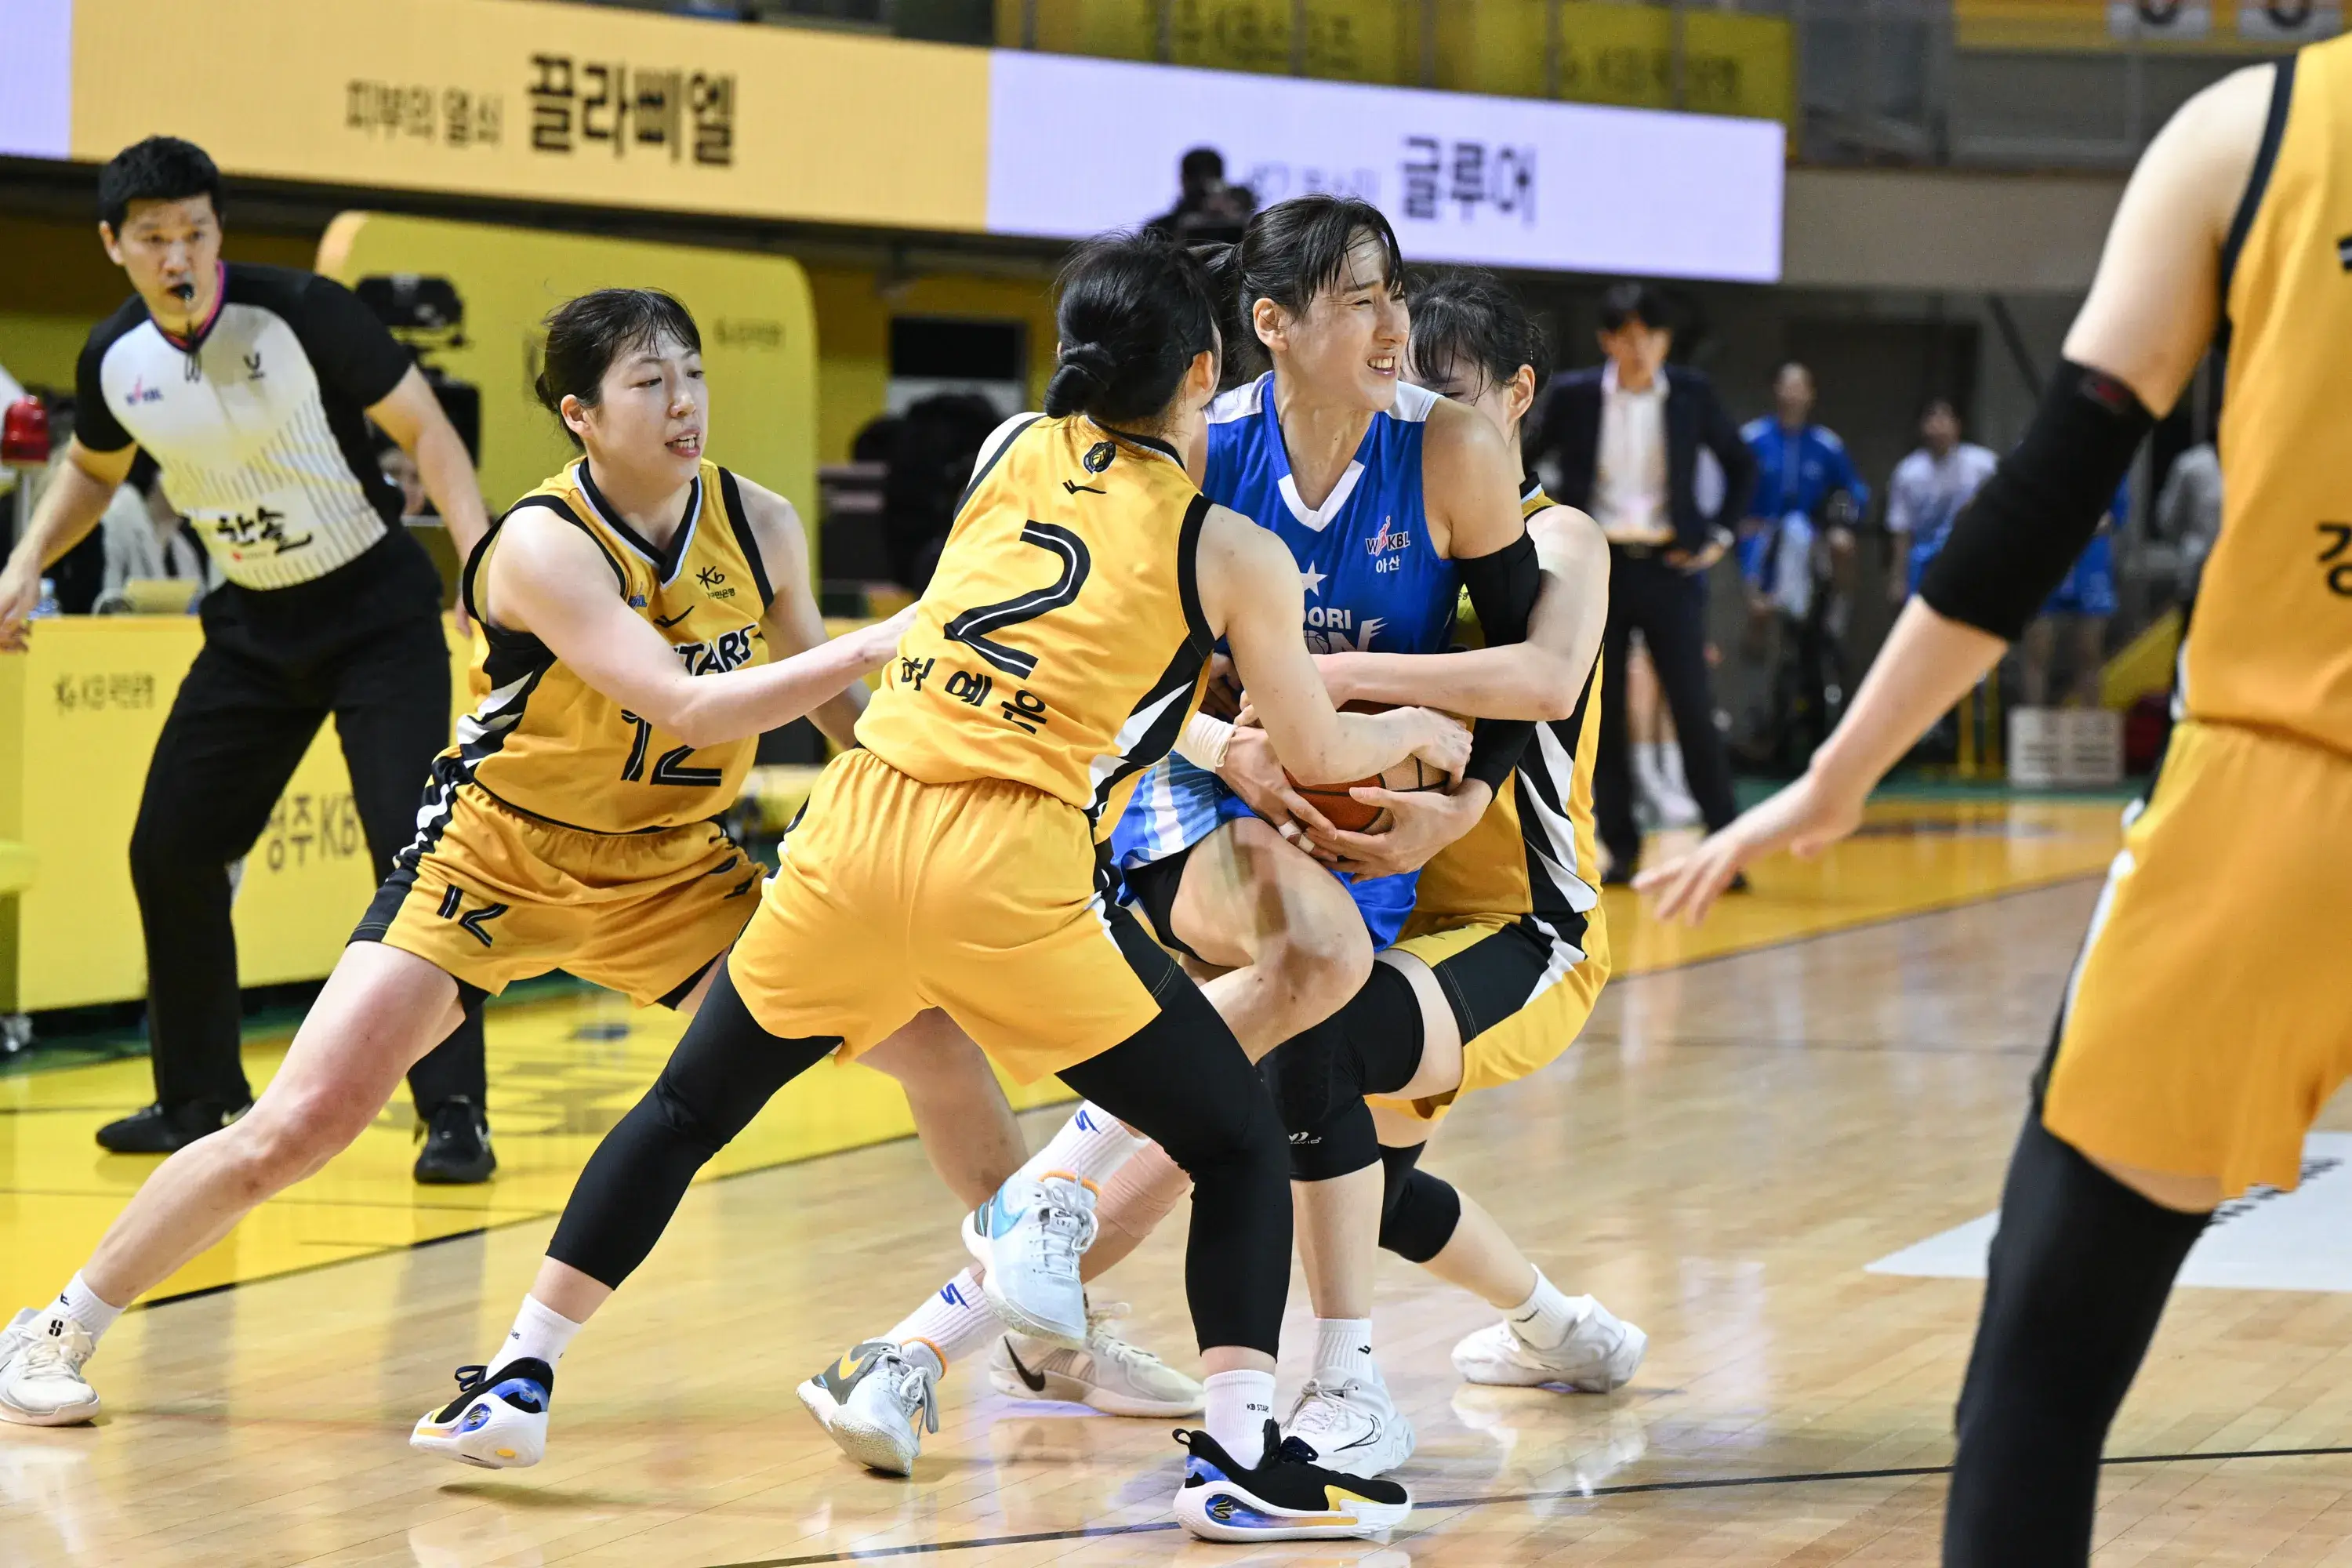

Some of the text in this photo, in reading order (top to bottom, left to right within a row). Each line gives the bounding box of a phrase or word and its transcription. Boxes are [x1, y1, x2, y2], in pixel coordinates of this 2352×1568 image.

[1365, 530, 1411, 556] WKBL
[1375, 555, 1400, 574] 아산
[943, 519, 1091, 681] 2
[1303, 606, 1352, 630] ORI
[673, 622, 758, 677] TARS
